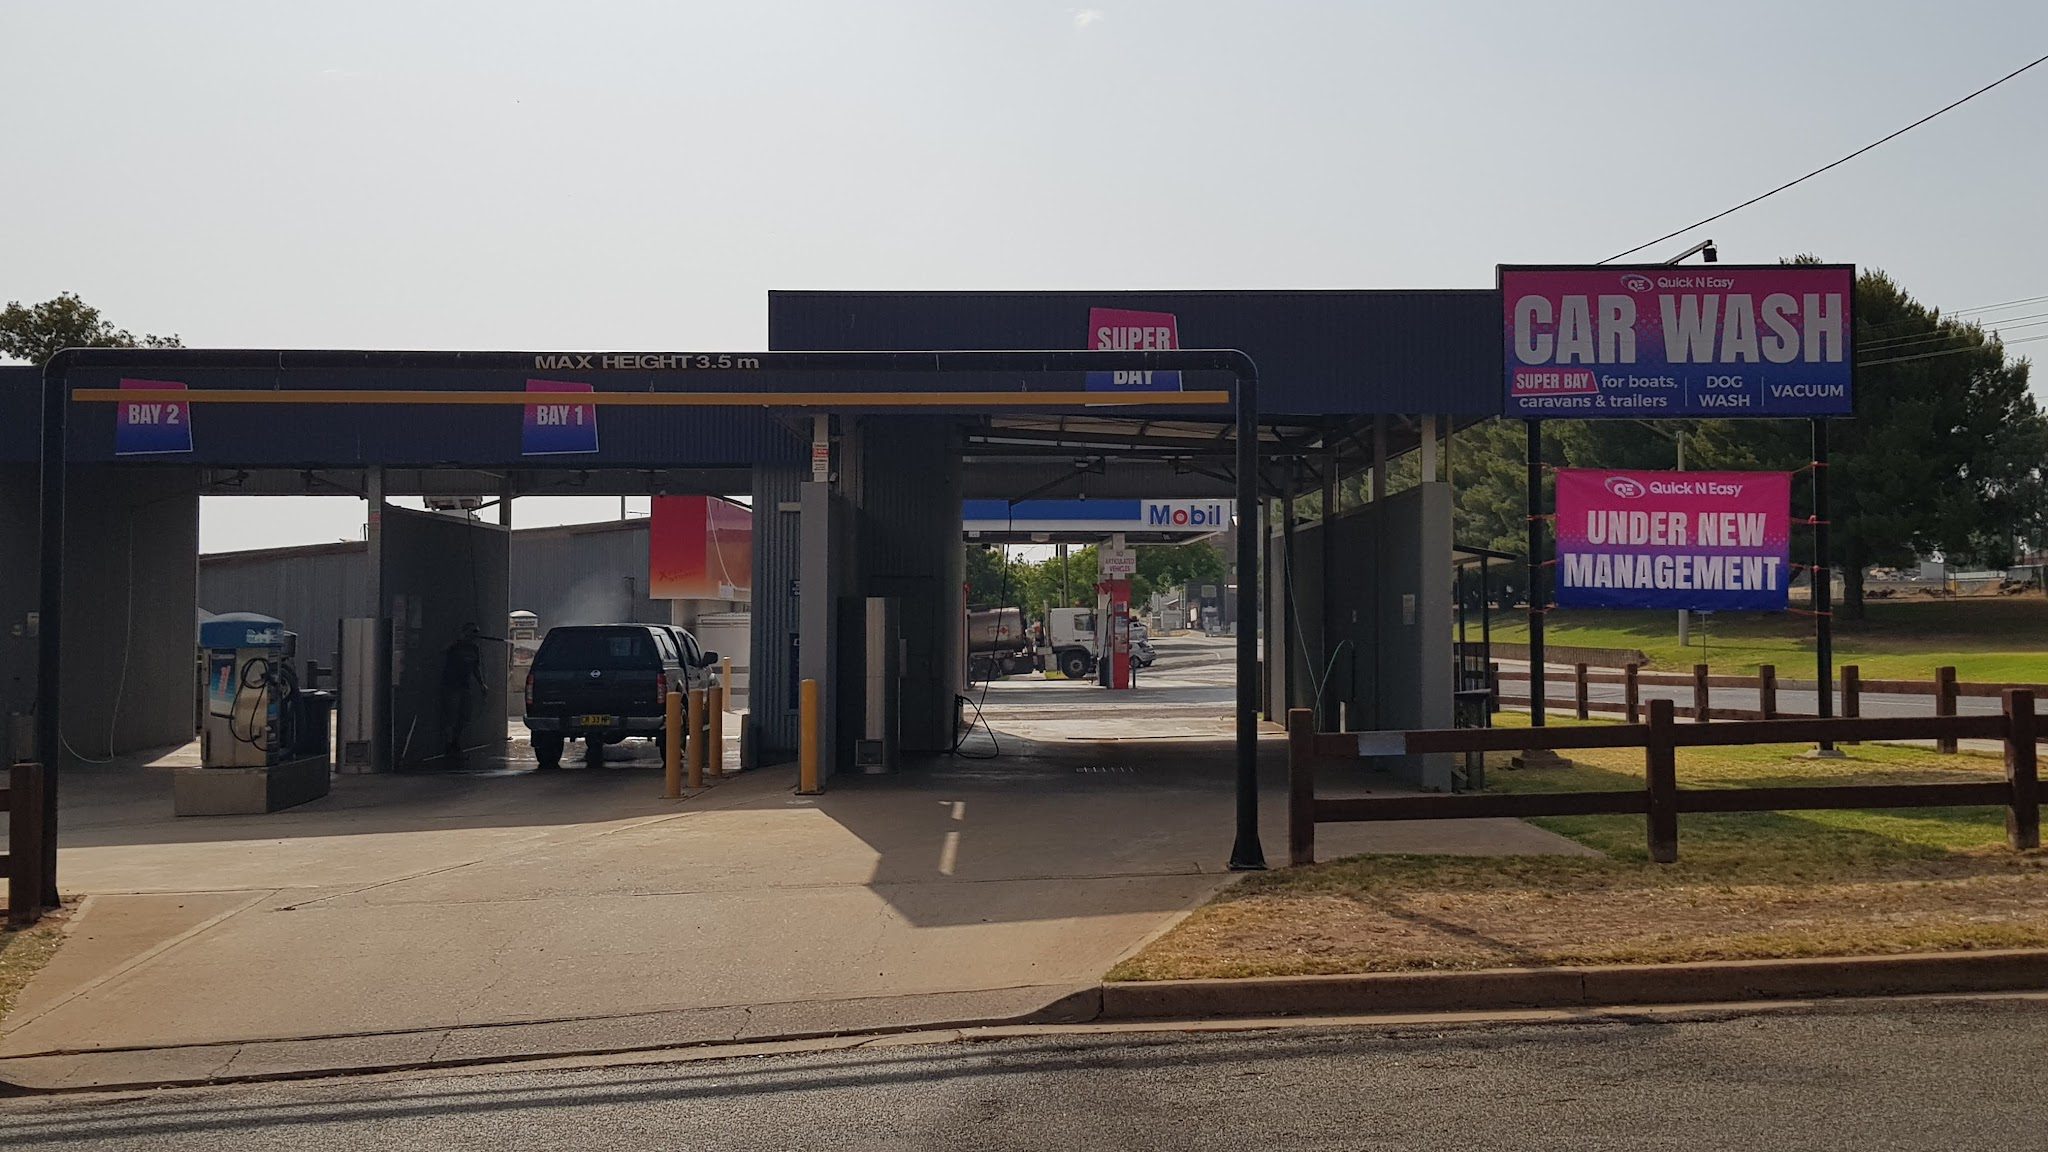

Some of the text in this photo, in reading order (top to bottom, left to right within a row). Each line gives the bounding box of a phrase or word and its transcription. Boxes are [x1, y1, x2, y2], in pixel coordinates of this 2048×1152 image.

[1657, 277, 1734, 289] Quick N Easy
[1514, 292, 1843, 365] CAR WASH
[1096, 326, 1171, 350] SUPER
[534, 355, 760, 369] MAX HEIGHT 3.5 m
[1516, 373, 1678, 389] SUPER BAY for boats,
[1706, 375, 1743, 389] DOG
[1770, 384, 1844, 398] VACUUM
[1519, 394, 1668, 408] caravans & trailers
[1699, 394, 1750, 407] WASH
[128, 404, 179, 425] BAY 2
[536, 405, 583, 426] BAY 1
[1649, 481, 1744, 498] Quick N Easy
[1150, 504, 1221, 526] Mobil
[1587, 510, 1767, 547] UNDER NEW
[1563, 552, 1781, 591] MANAGEMENT
